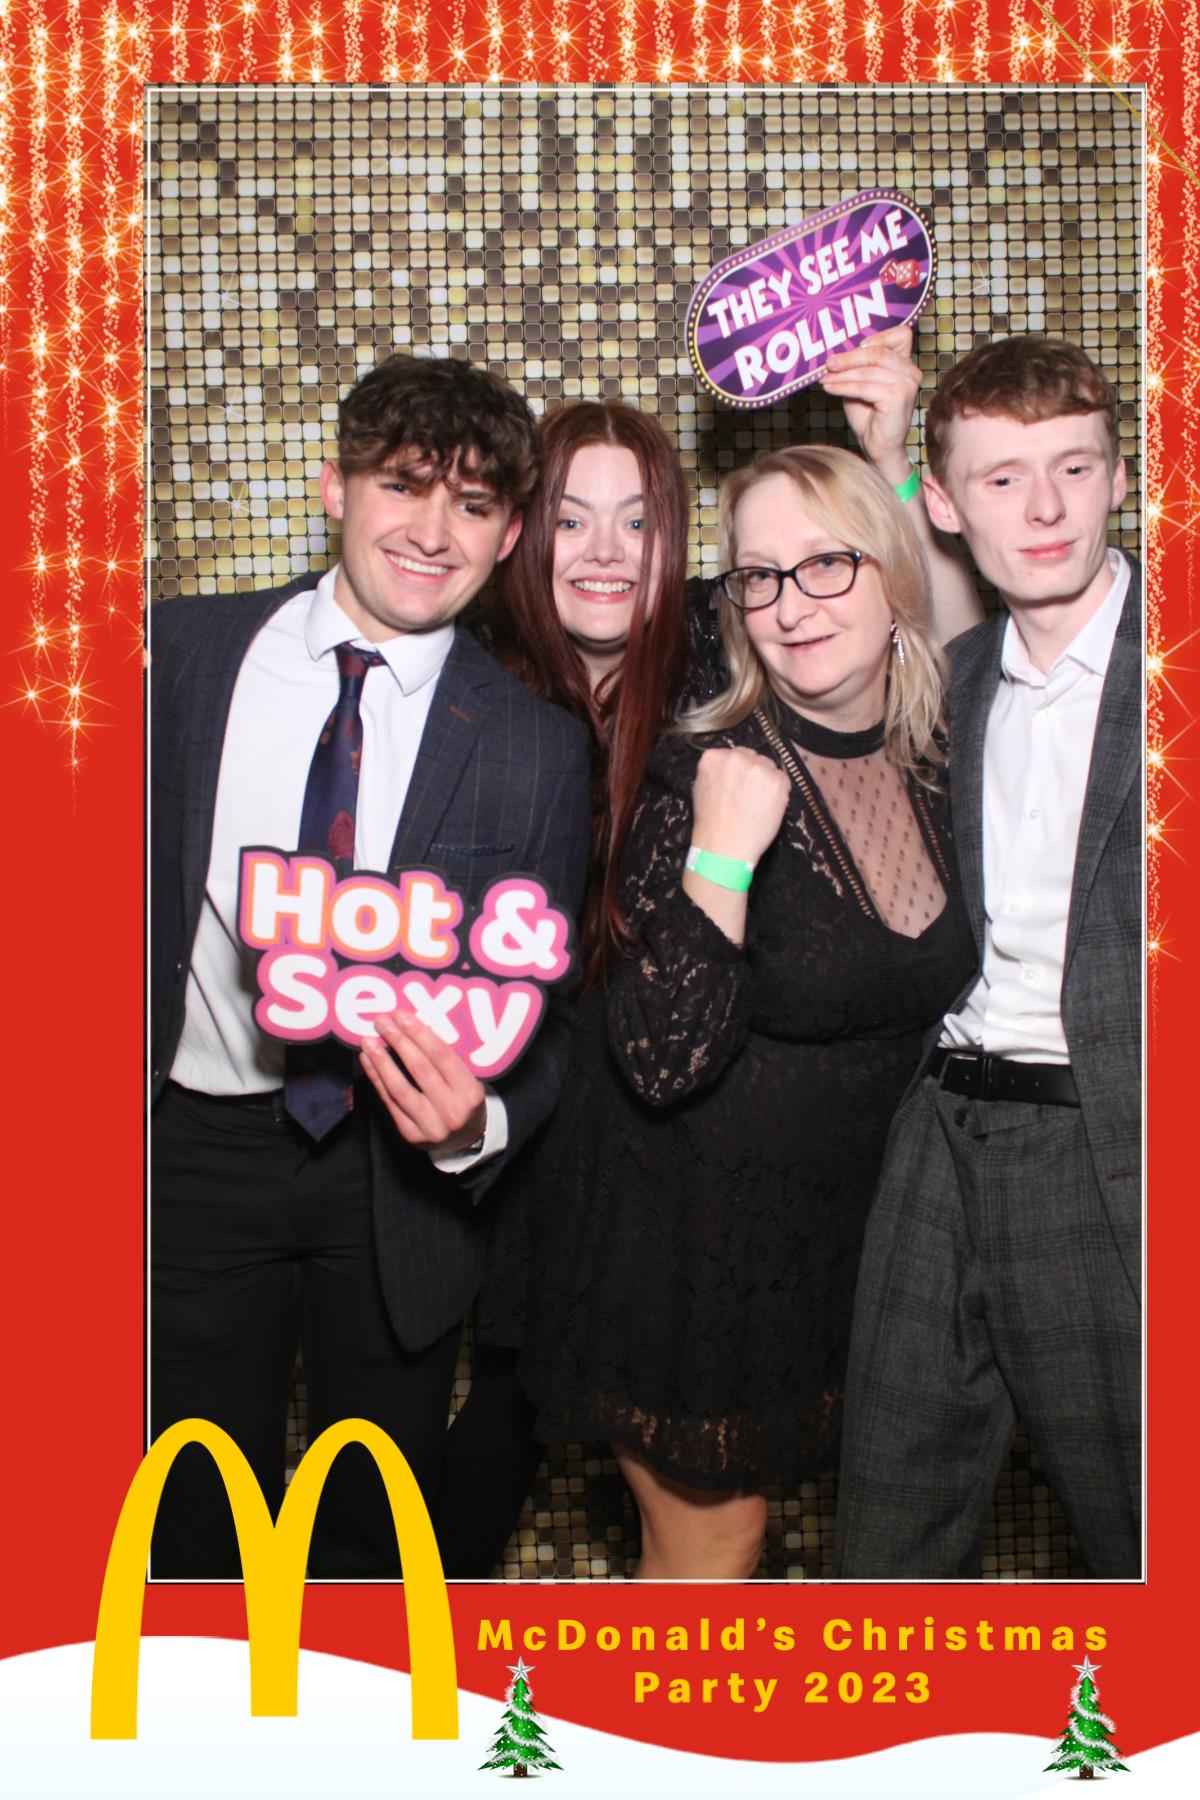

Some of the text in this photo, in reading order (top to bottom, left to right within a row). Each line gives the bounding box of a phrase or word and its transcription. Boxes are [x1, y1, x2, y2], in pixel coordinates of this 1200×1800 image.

[706, 209, 908, 339] THEY SEE ME
[734, 279, 889, 391] ROLLIN
[250, 861, 559, 970] Hot &
[266, 953, 532, 1068] Sexy
